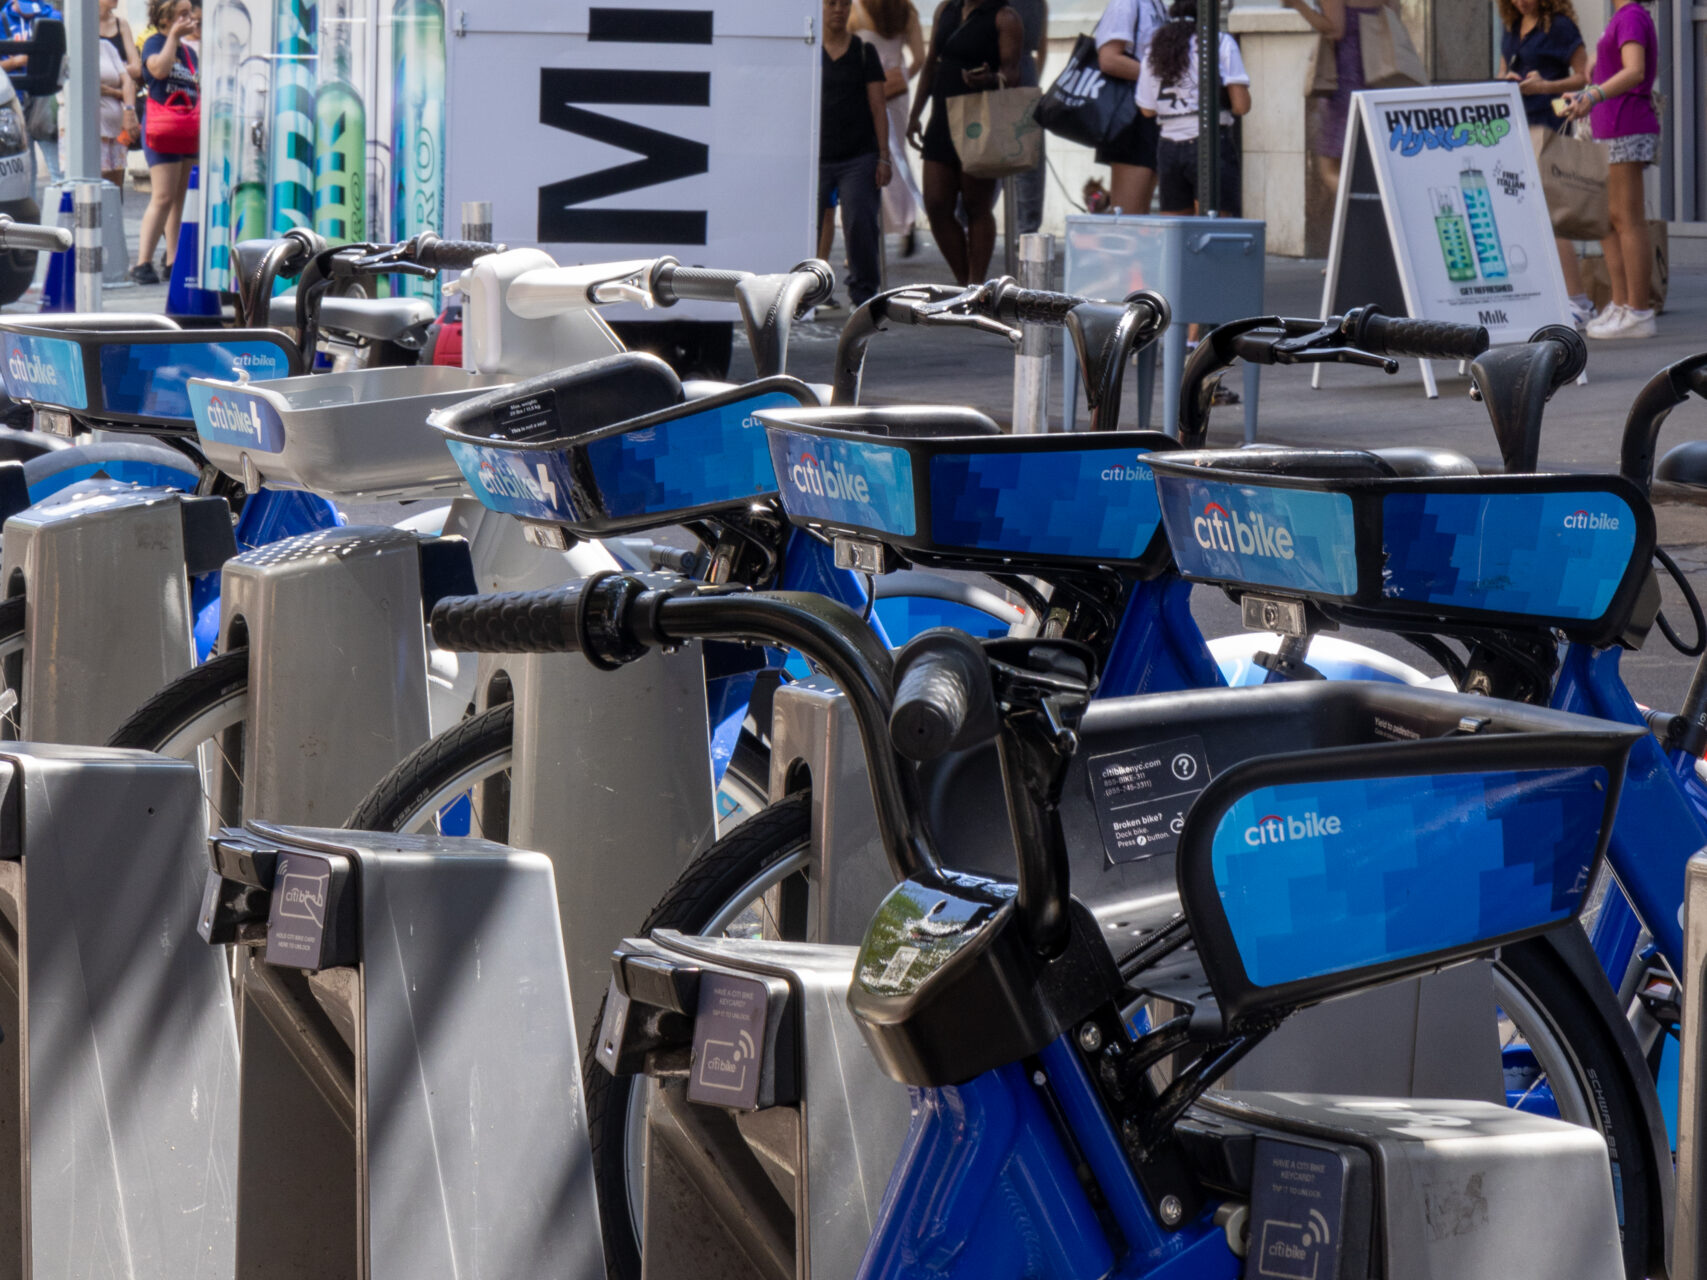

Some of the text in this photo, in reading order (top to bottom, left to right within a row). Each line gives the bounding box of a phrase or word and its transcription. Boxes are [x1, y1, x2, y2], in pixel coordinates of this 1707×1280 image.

[1385, 103, 1511, 133] HYDRO GRIP
[1497, 177, 1526, 191] ITALIAN
[1459, 284, 1514, 296] GET REFRESHED
[1478, 309, 1510, 325] Milk
[9, 349, 57, 385] citi bike
[232, 353, 276, 367] citi bike
[207, 395, 228, 428] citi
[225, 400, 255, 434] bike
[478, 461, 547, 503] citi bike
[793, 452, 870, 504] citi bike
[1101, 464, 1154, 481] citi bike
[1563, 510, 1619, 531] citi bike
[1194, 502, 1295, 560] citi bike
[1102, 759, 1162, 778] citibikenyc.com
[1112, 812, 1164, 831] Broken bike?
[1244, 812, 1342, 846] citi bike
[1115, 828, 1133, 840] Dock
[1117, 831, 1170, 848] Press button.
[286, 888, 299, 903] citi
[708, 1057, 736, 1073] citi bike
[1587, 1067, 1618, 1158] SCHWALBE
[1268, 1241, 1307, 1260] citi bike
